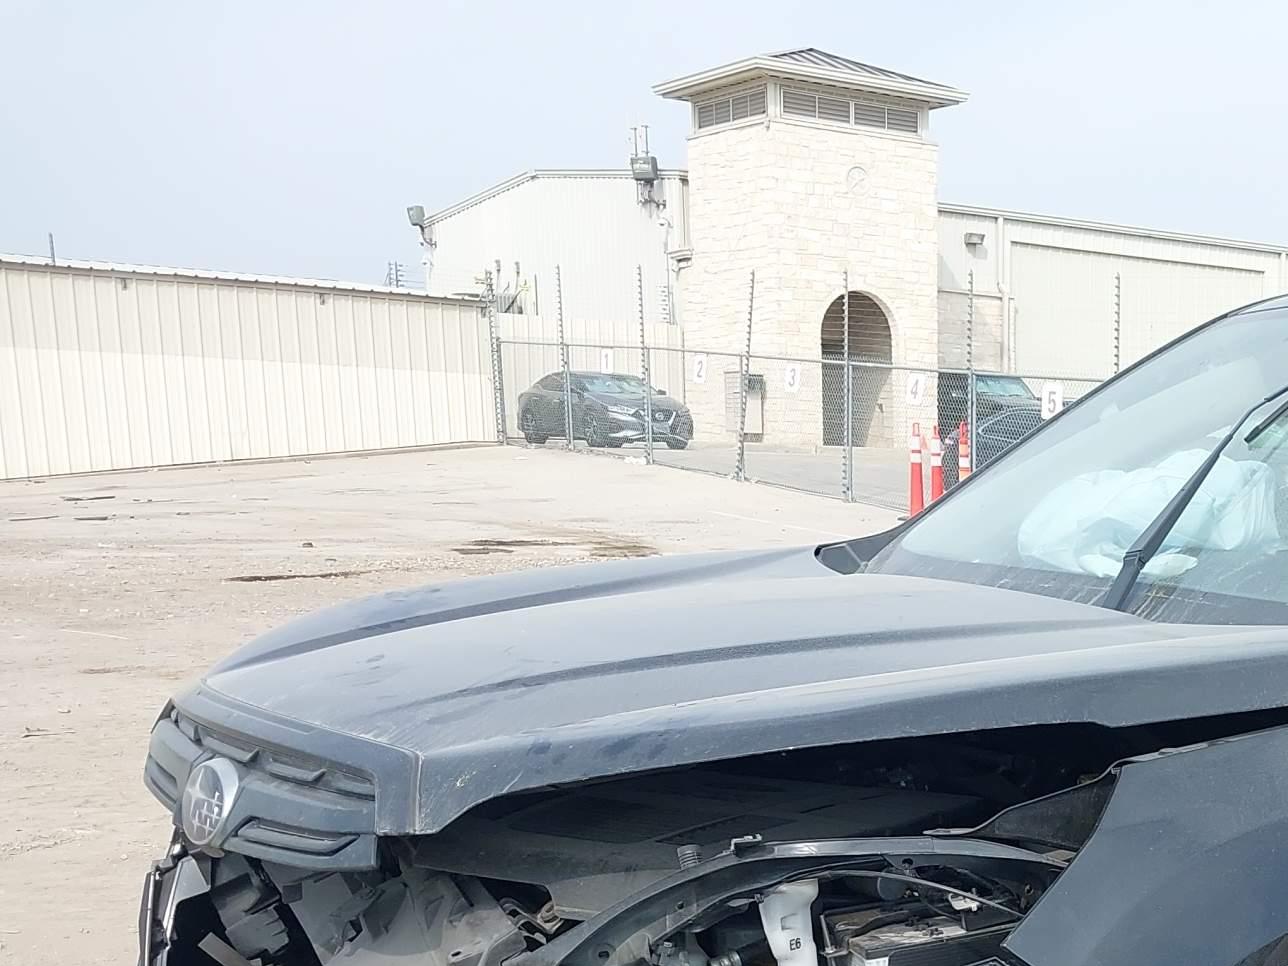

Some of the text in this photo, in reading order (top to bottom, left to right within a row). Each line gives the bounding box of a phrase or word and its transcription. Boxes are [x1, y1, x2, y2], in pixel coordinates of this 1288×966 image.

[697, 360, 703, 378] 2
[788, 368, 796, 387] 3
[910, 378, 919, 399] 4
[1048, 391, 1056, 413] 5
[789, 937, 801, 951] E6
